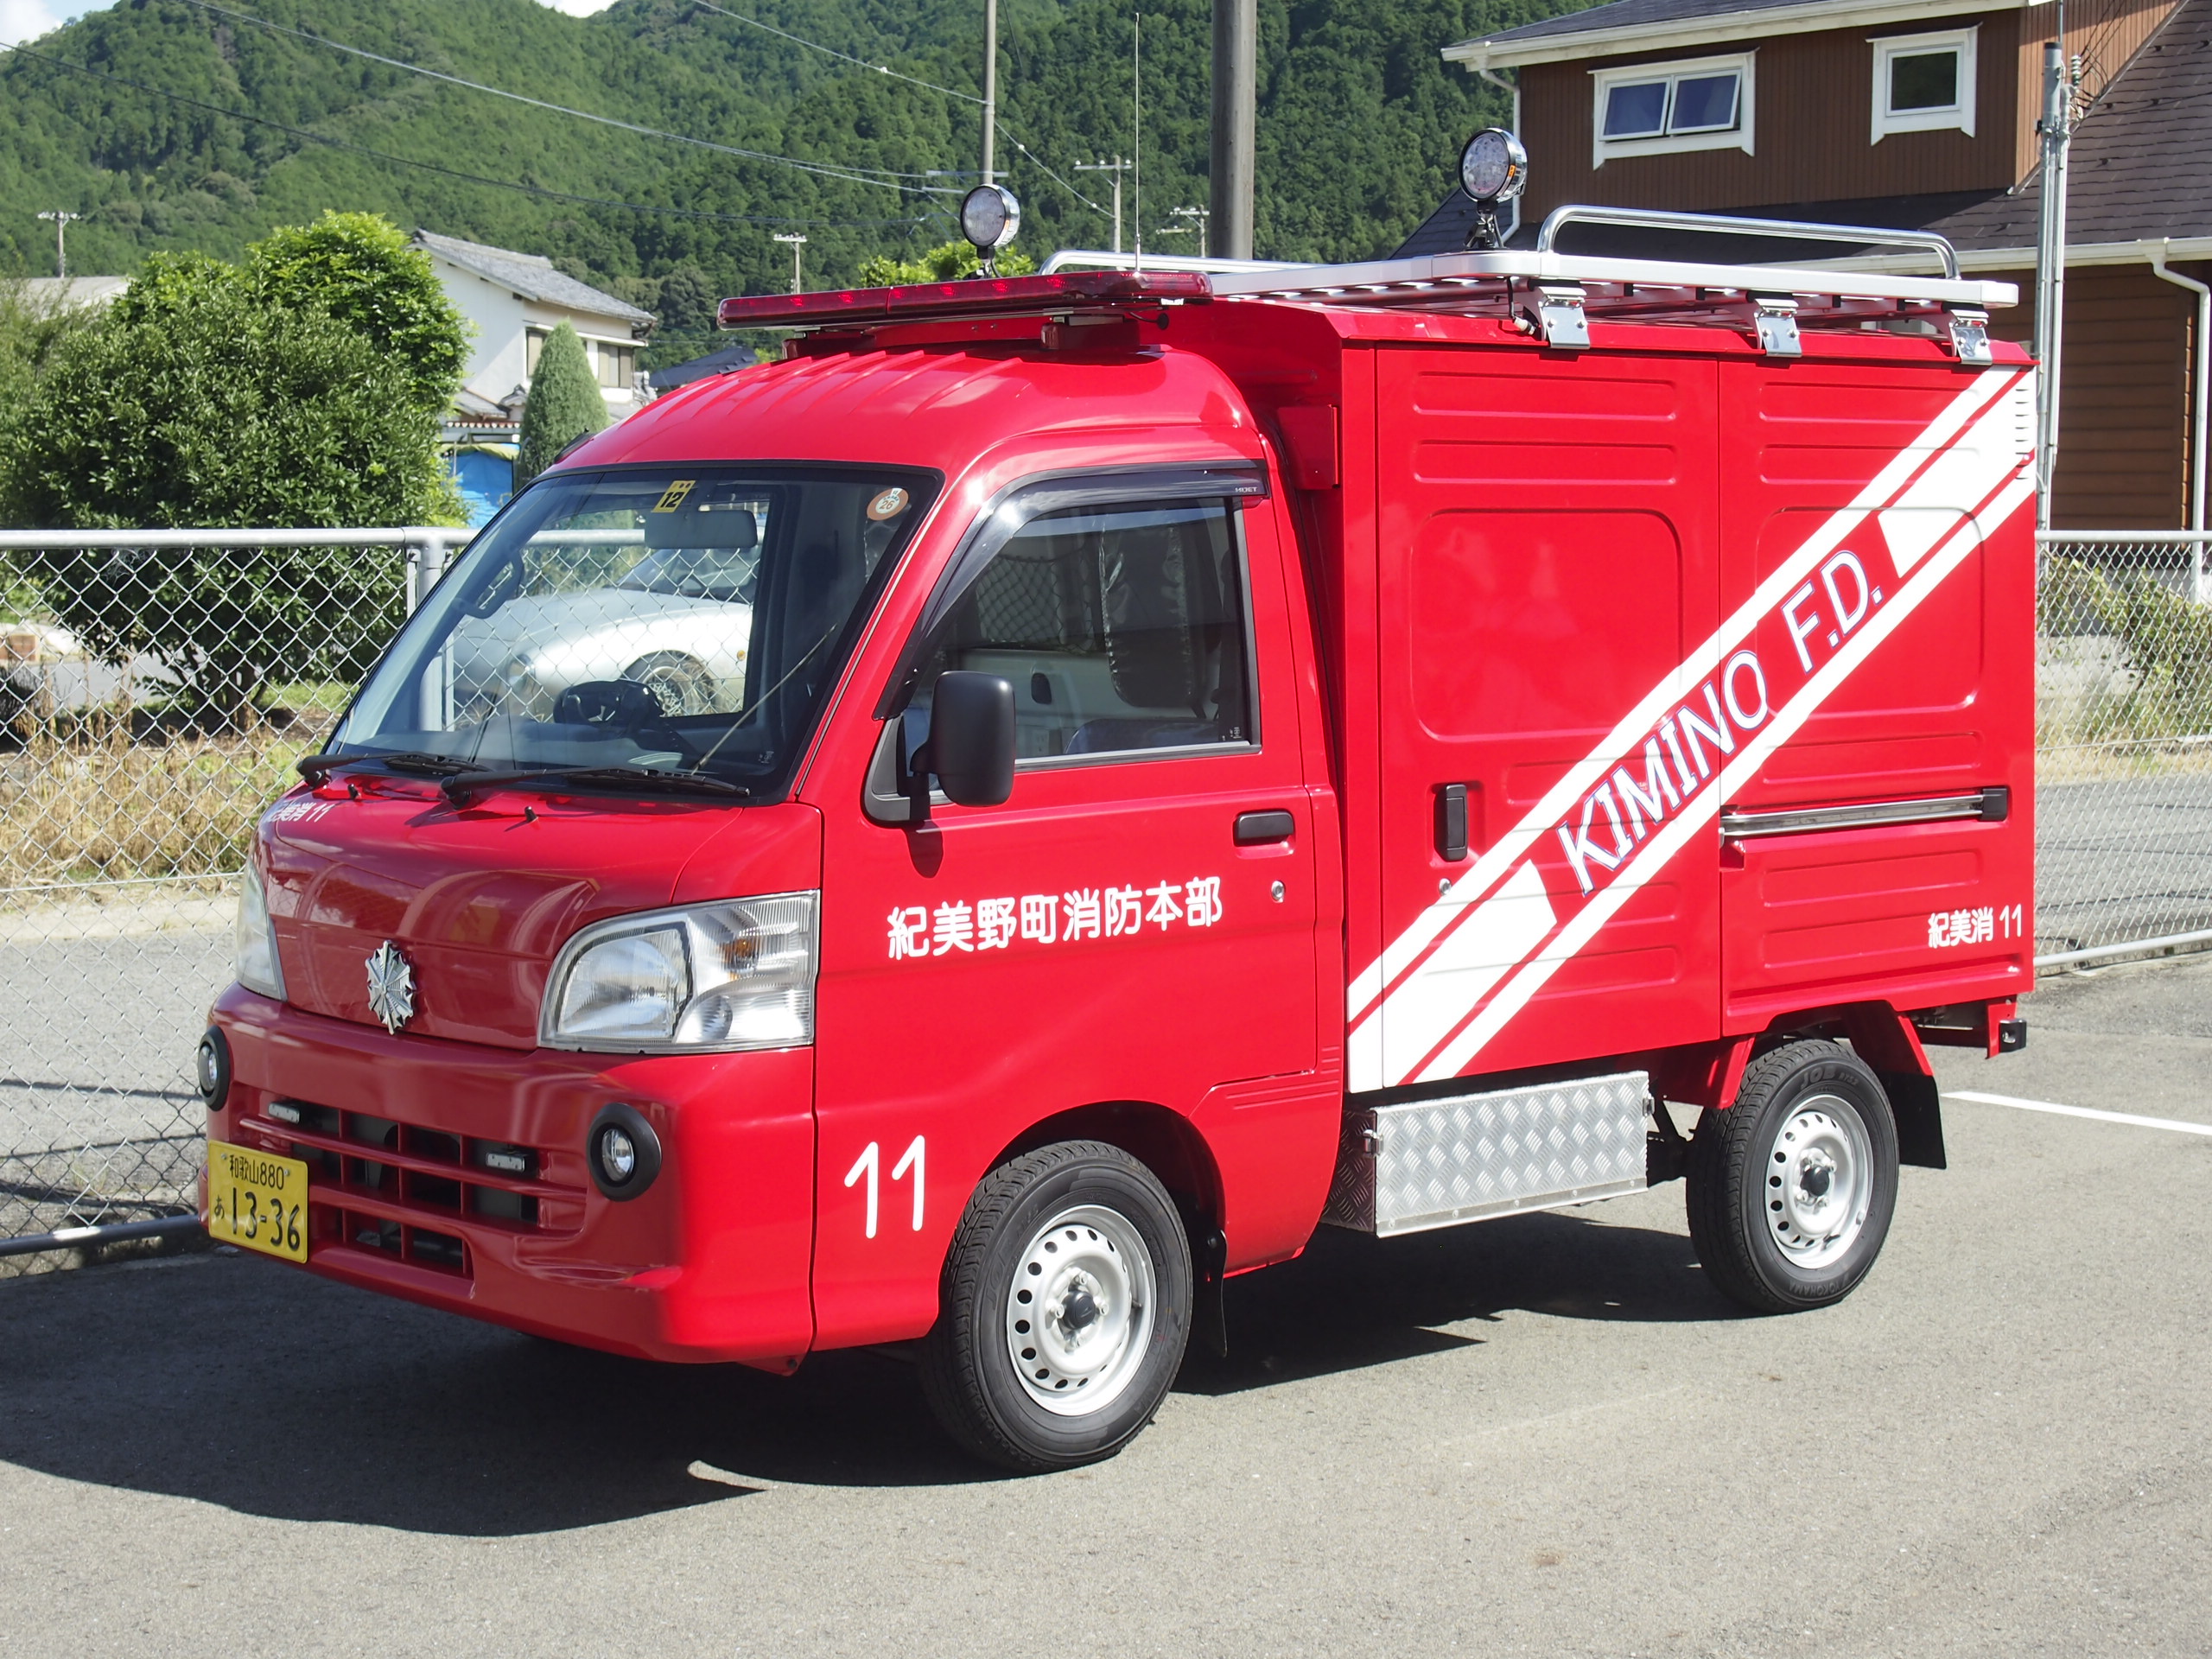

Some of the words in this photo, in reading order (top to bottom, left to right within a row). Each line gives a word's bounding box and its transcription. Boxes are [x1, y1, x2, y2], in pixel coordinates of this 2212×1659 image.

[660, 491, 684, 508] 12
[879, 499, 895, 510] 26
[1555, 650, 1770, 898] KIMINO
[1781, 550, 1885, 674] F.D.
[306, 803, 335, 823] 11
[887, 875, 1224, 961] 紀美野町消防本部
[1928, 906, 1994, 950] 紀美消
[1999, 904, 2023, 938] 11
[229, 1154, 284, 1190] 和歌山880
[843, 1134, 926, 1239] 11
[213, 1194, 225, 1219] あ
[232, 1186, 301, 1252] 13-36
